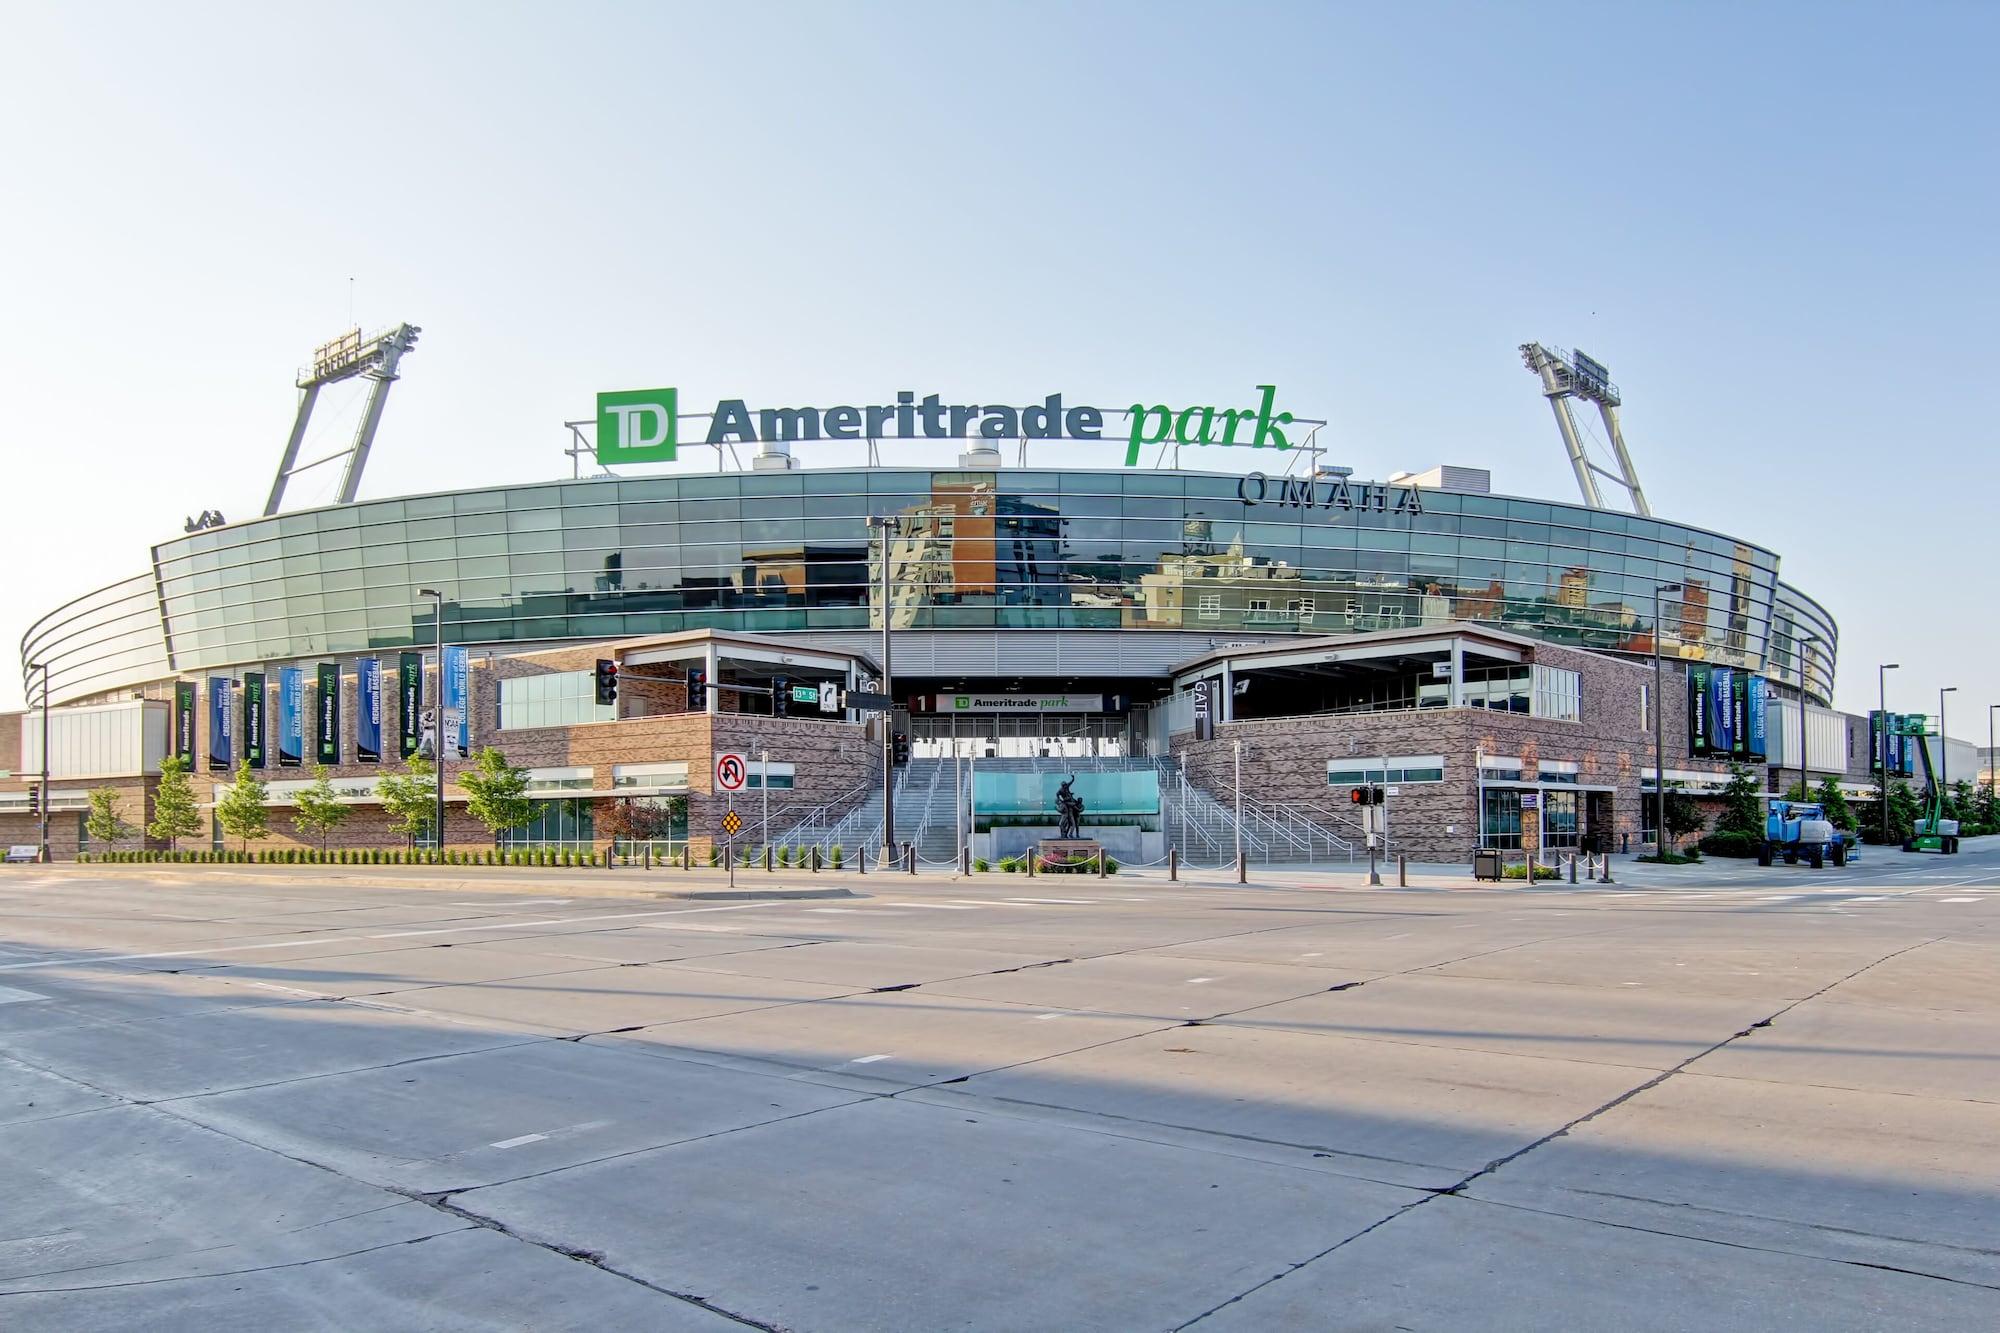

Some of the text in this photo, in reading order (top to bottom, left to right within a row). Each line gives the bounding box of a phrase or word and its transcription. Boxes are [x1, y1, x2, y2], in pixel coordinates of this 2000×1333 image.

[604, 385, 1295, 467] TD Ameritrade park
[1242, 471, 1426, 514] OMAHA
[323, 674, 335, 695] park
[372, 660, 380, 724] CREIGHTON BASEBALL
[406, 664, 417, 686] park
[1694, 672, 1705, 692] park
[325, 696, 333, 741] Ameritrade
[407, 686, 415, 735] Ameritrade
[866, 681, 880, 719] GE
[917, 695, 926, 712] 1
[973, 698, 1038, 707] Ameritrade
[1040, 695, 1069, 711] park
[1112, 695, 1121, 711] 1
[1195, 681, 1208, 719] GATE
[182, 710, 190, 751] Ameritrade
[251, 703, 259, 746] Ameritrade
[1734, 701, 1742, 741] Ameritrade
